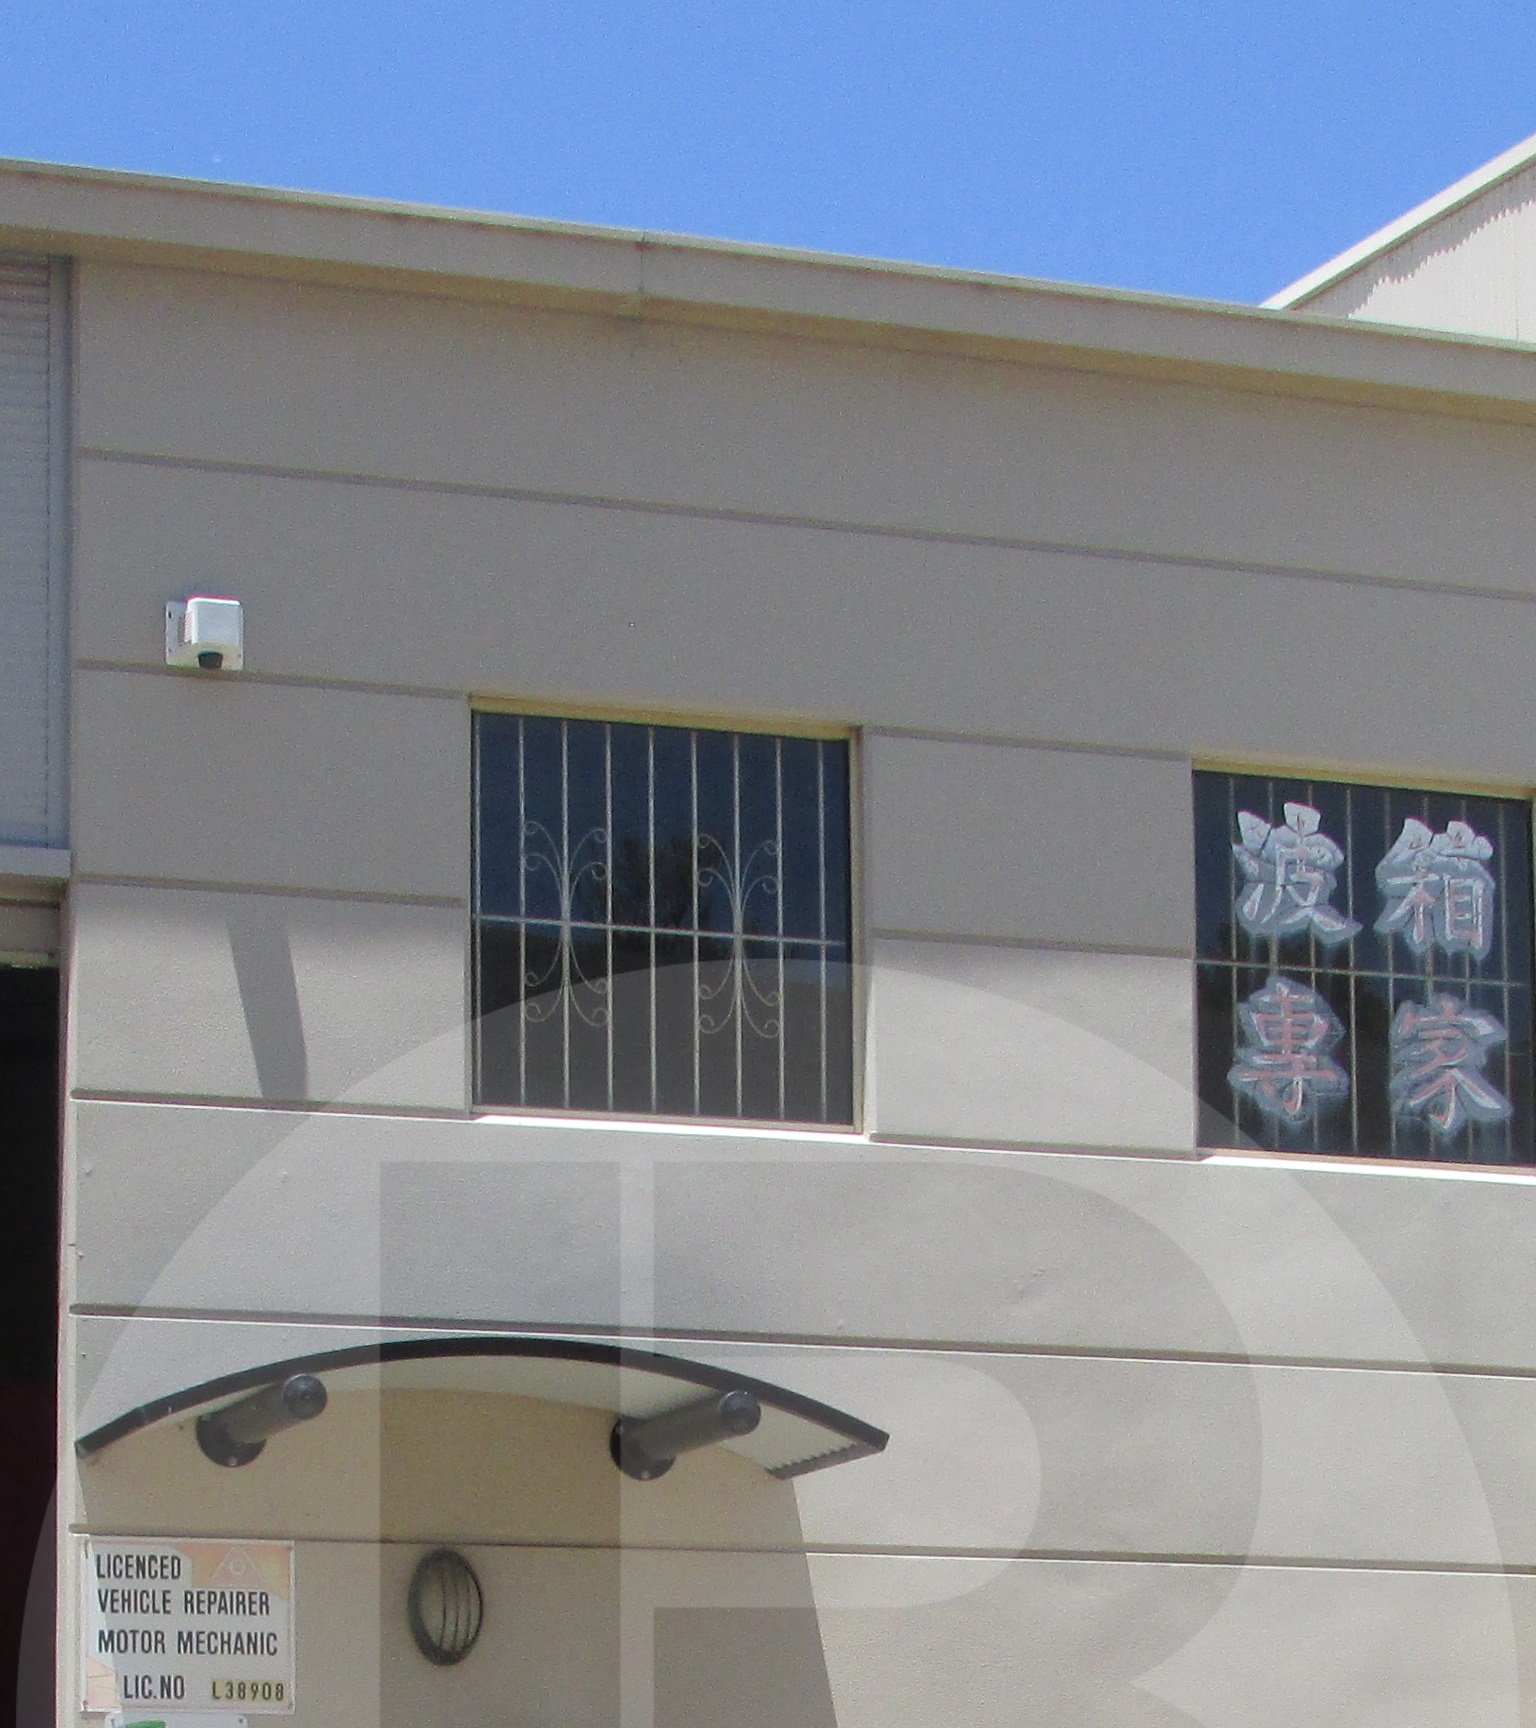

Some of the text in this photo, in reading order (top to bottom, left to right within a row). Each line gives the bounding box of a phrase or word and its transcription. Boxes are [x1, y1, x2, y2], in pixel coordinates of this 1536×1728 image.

[96, 1553, 181, 1580] LICENCED
[97, 1588, 270, 1616] VEHICLE REPAIRER
[97, 1629, 278, 1656] MOTOR MECHANIC
[123, 1674, 285, 1701] LIC.NO L38908
